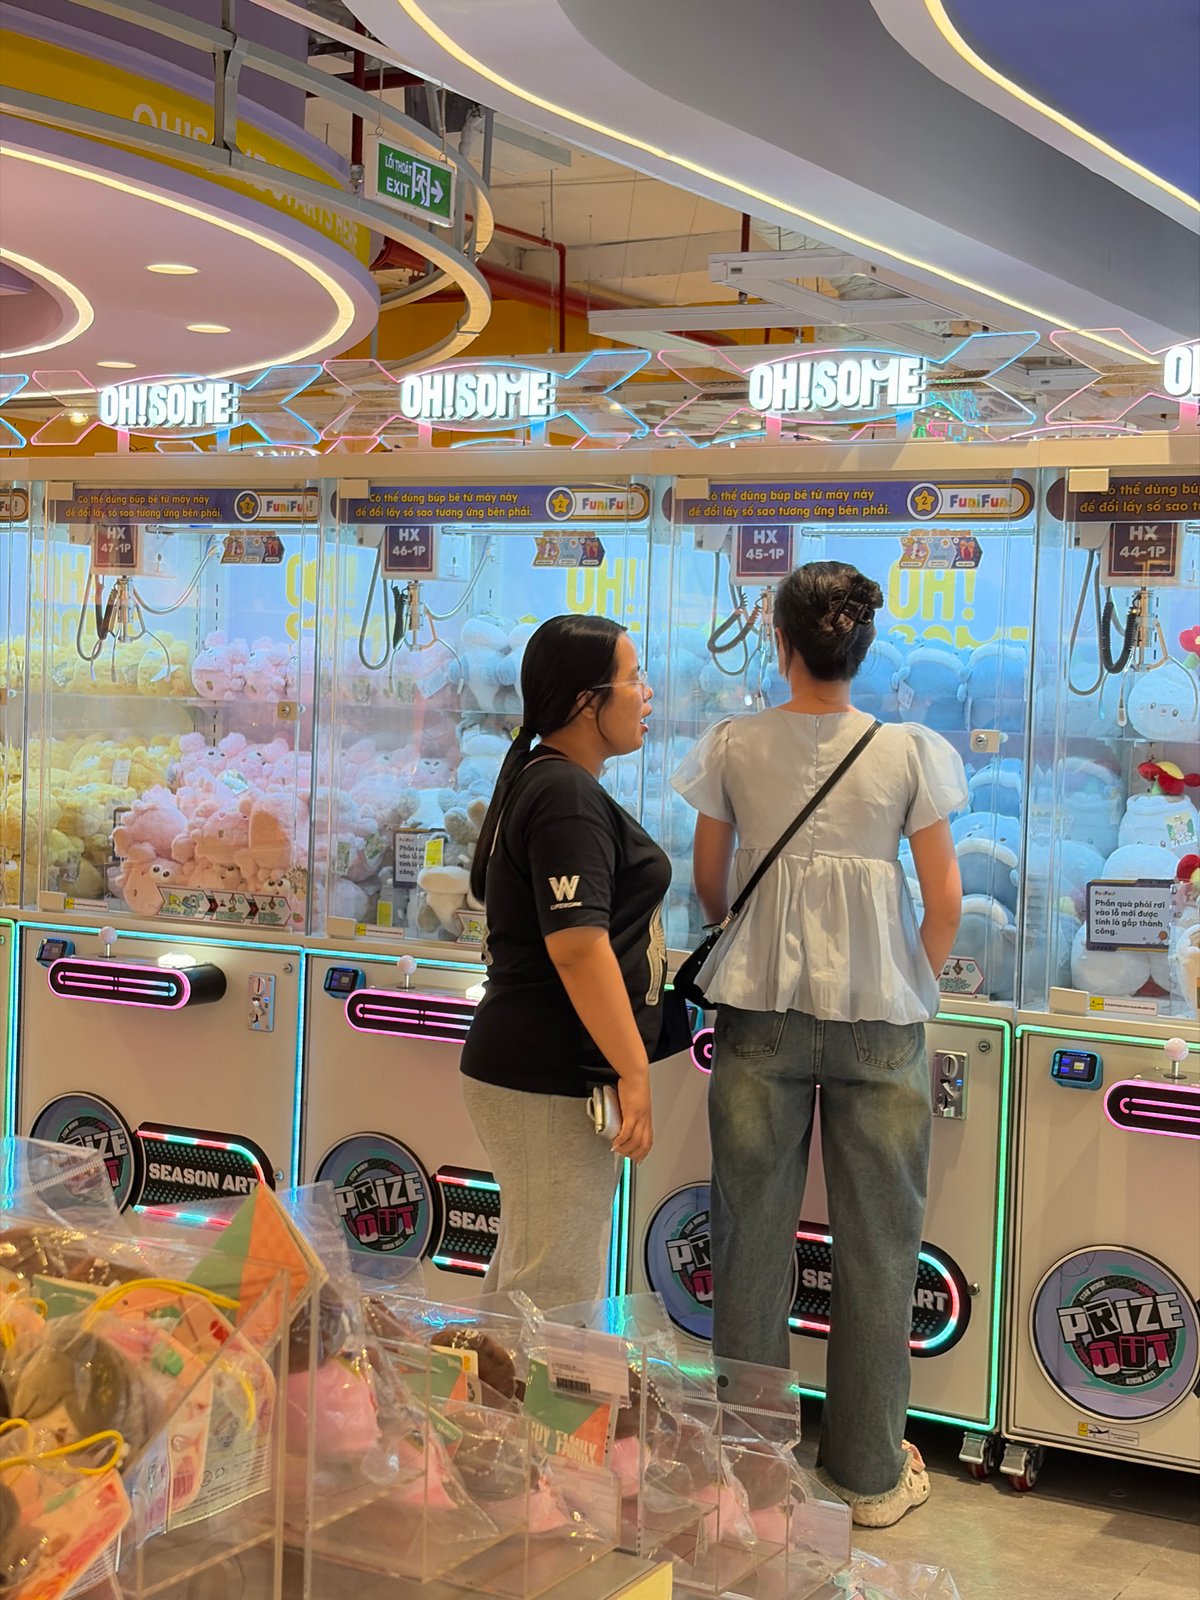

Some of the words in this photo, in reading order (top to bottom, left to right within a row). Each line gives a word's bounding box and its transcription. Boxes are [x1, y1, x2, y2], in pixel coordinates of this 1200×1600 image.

[386, 177, 410, 197] EXIT
[749, 357, 924, 413] OH!SOME
[100, 382, 238, 427] OH!SOME
[401, 371, 555, 420] OH!SOME
[1182, 482, 1200, 496] bú
[921, 496, 929, 505] 2
[950, 493, 1012, 508] FuniFun!
[1146, 498, 1162, 512] số
[1165, 503, 1188, 512] sao
[416, 509, 433, 517] sao
[756, 507, 776, 516] sao
[107, 526, 126, 539] HX
[399, 528, 420, 542] HX
[754, 529, 778, 544] HX
[1129, 525, 1158, 541] HX
[101, 543, 131, 553] 47-1P
[392, 545, 426, 556] 46-1P
[745, 548, 785, 560] 45-1P
[1119, 546, 1166, 558] 44-1P
[566, 557, 637, 616] OH!
[888, 560, 977, 621] OH!
[548, 875, 580, 901] W
[149, 1162, 219, 1190] SEASON
[222, 1174, 259, 1195] ART
[334, 1171, 425, 1217] PRIZE
[355, 1205, 416, 1244] OUT
[449, 1210, 500, 1234] SEAS
[914, 1288, 948, 1312] RT
[1057, 1292, 1185, 1343] PRIZE
[1089, 1333, 1172, 1376] OUT
